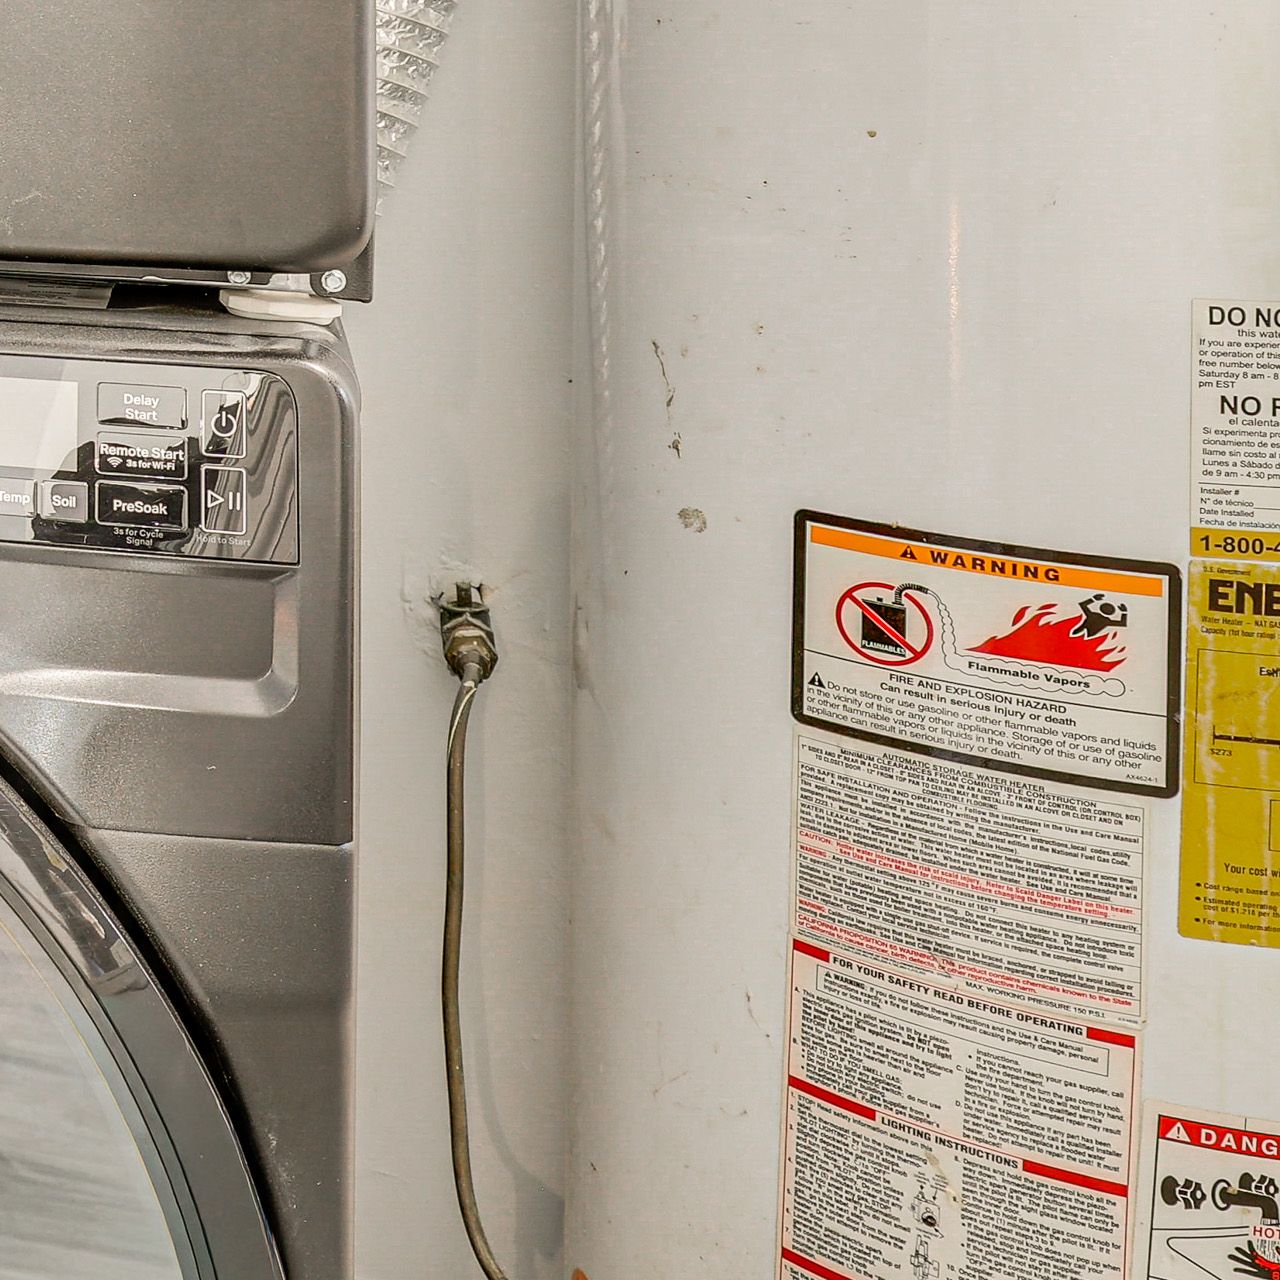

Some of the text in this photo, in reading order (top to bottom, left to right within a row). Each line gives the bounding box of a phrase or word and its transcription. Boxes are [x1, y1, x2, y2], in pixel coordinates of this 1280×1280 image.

[1209, 306, 1246, 326] DO
[1238, 329, 1256, 337] this
[1199, 370, 1239, 380] Saturday
[124, 394, 159, 408] Delay
[1221, 395, 1261, 416] NO
[125, 408, 158, 421] Start
[1229, 417, 1238, 425] el
[100, 444, 184, 461] Remote Start
[126, 460, 138, 468] 3s
[152, 460, 175, 470] Wi-Fi
[1201, 487, 1231, 495] Installer
[52, 495, 76, 507] Soil
[113, 499, 168, 515] PreSoak
[1221, 509, 1254, 517] Installed
[125, 528, 138, 536] for
[140, 529, 163, 540] Cycle
[126, 536, 153, 547] Signal
[196, 534, 251, 546] Hold to Start
[930, 550, 1060, 581] WARNING
[862, 640, 906, 655] FLAMMABLES
[968, 661, 1090, 689] Flammable Vapors
[890, 673, 1067, 714] FIRE AND EXPLOSION HAZARD
[880, 682, 1076, 727] Can result in serious injury or death
[828, 681, 1157, 752] Do not store or use gasoline or other flammable vapors and liquids
[807, 686, 1162, 763] in the vicinity of this or any other appliance. Storage of or use of gasoline
[1224, 862, 1268, 876] Your cost
[833, 956, 1083, 1036] FOR YOUR SAFETY READ BEFORE OPERATING
[881, 1117, 1019, 1169] LIGHTING INSTRUCTIONS
[1200, 1128, 1278, 1156] DANG
